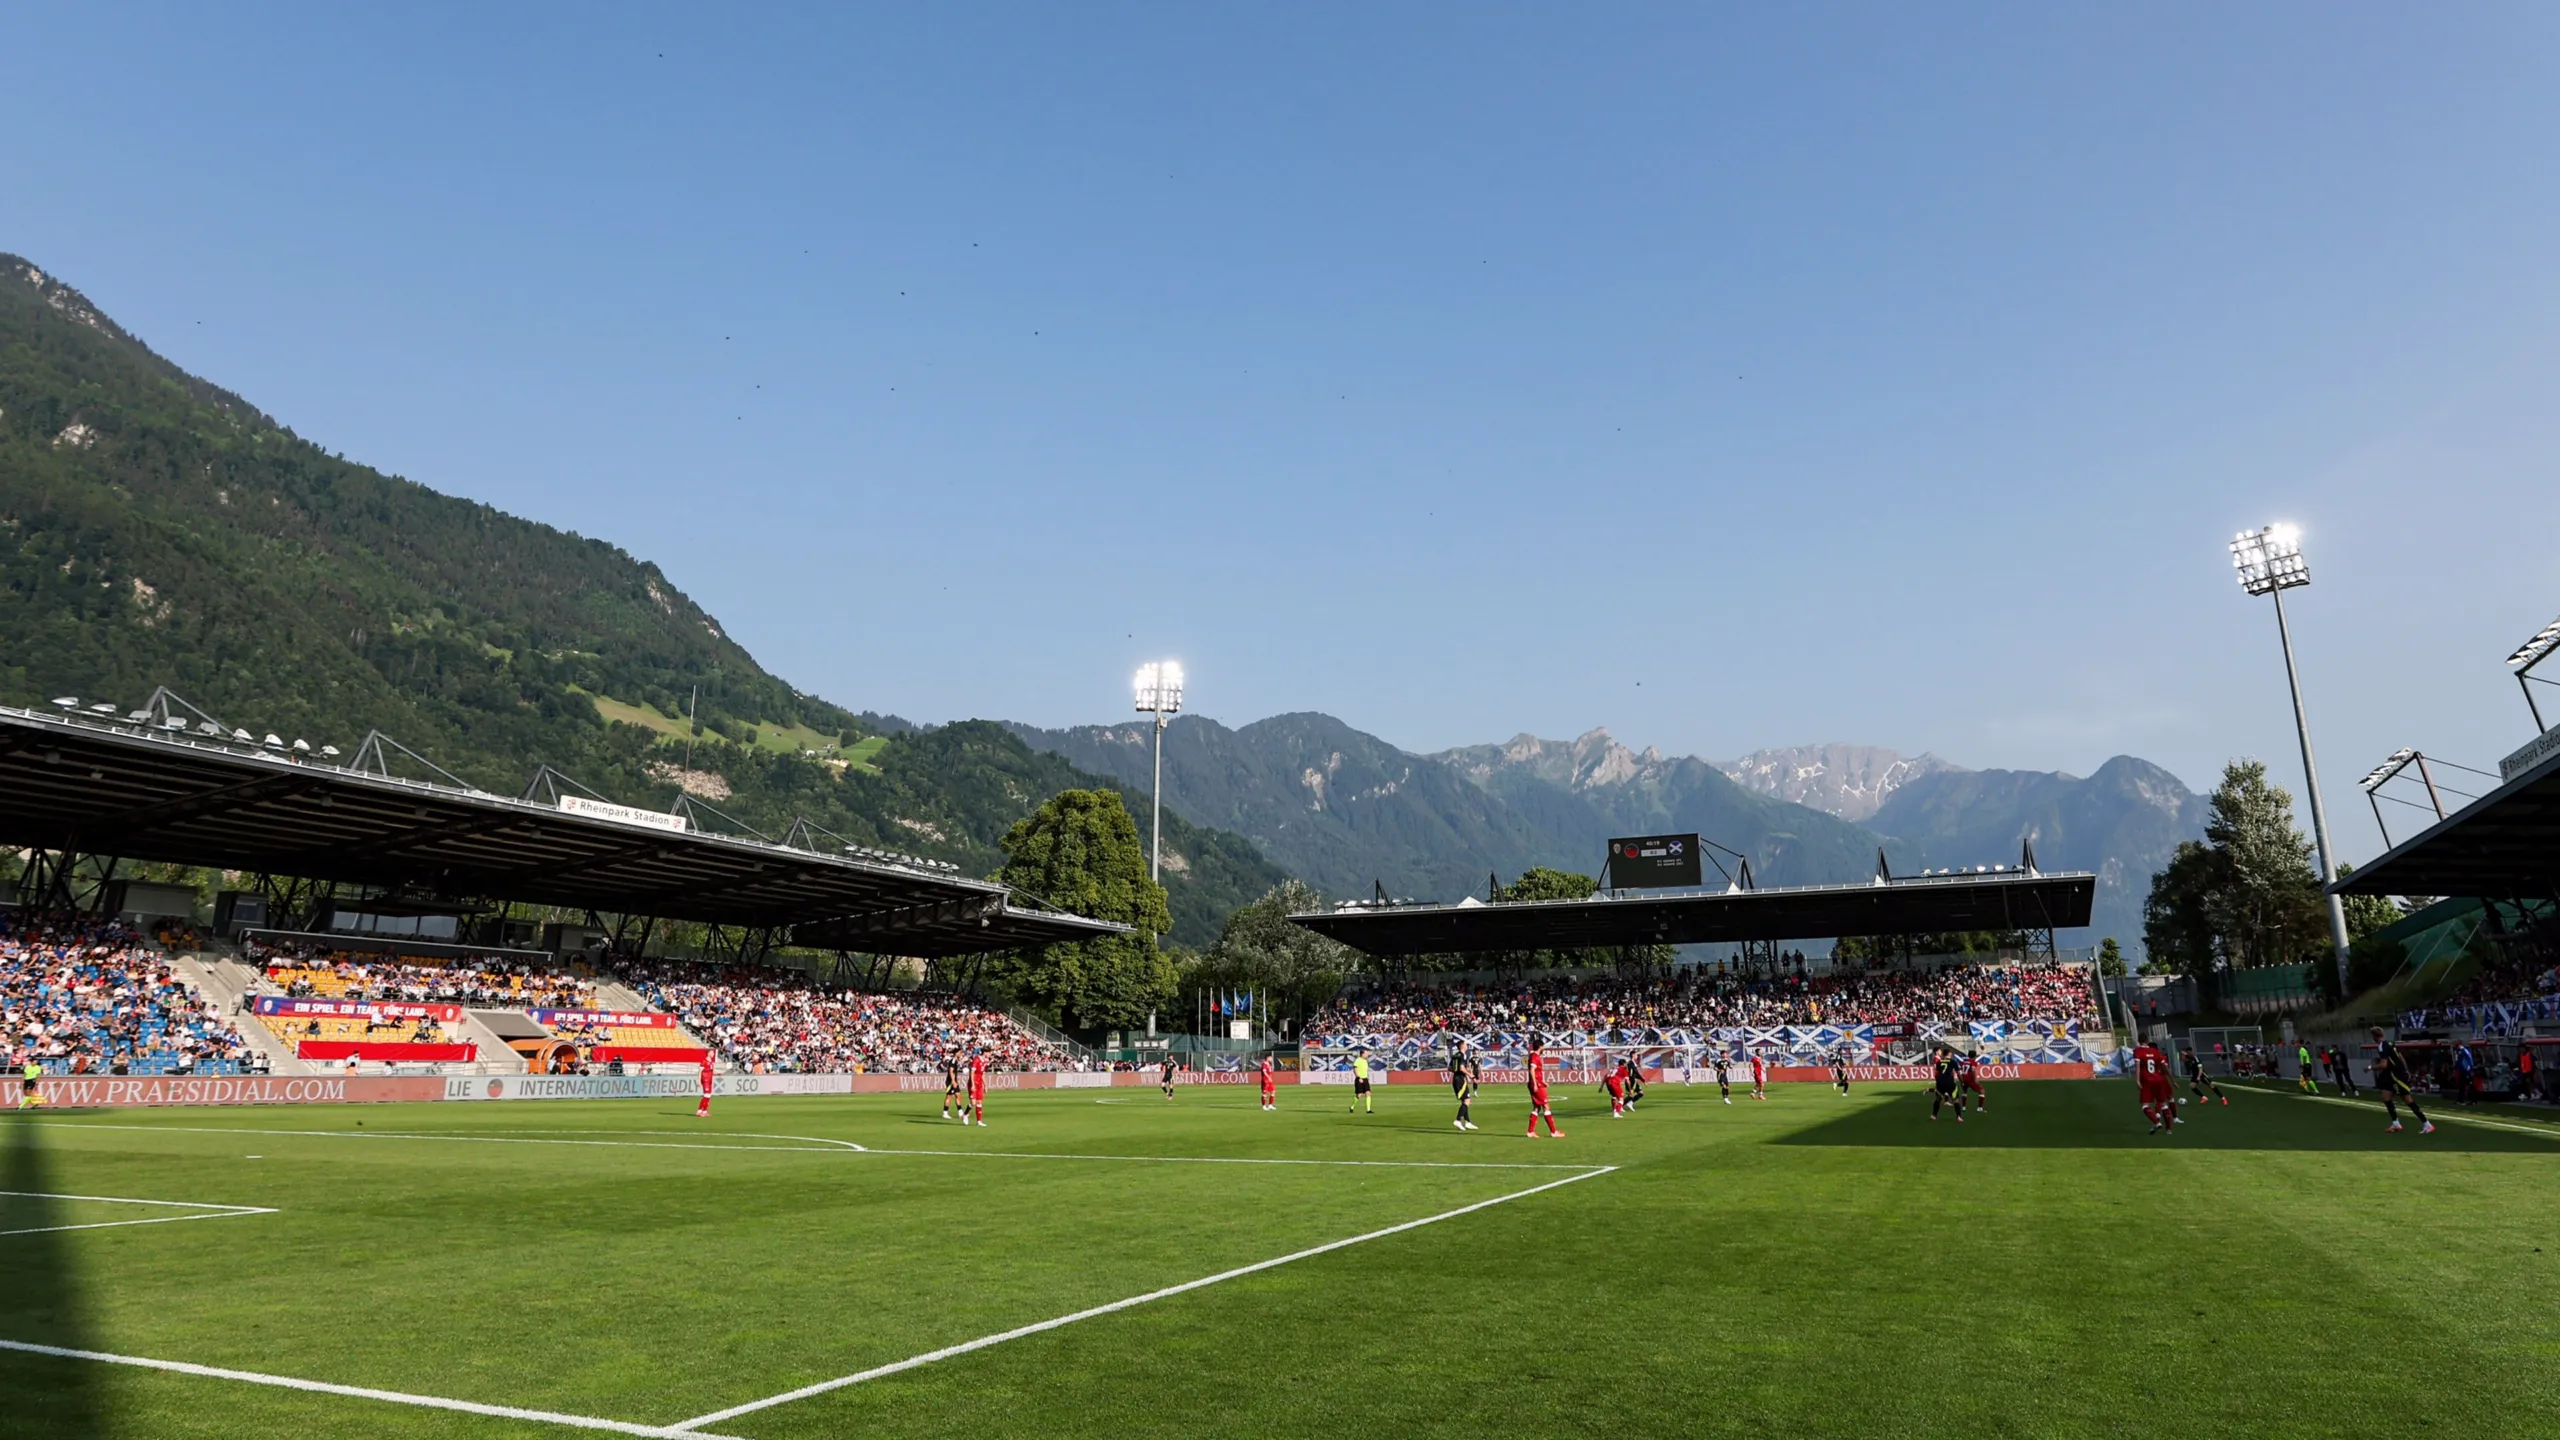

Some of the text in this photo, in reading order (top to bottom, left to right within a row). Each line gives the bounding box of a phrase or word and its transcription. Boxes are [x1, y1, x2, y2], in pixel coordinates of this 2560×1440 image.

[580, 801, 670, 826] Rheinpark Stadion
[294, 1002, 310, 1013] EIN
[311, 1003, 338, 1014] SPIEL.
[340, 1004, 355, 1015] EIN
[1940, 1063, 1948, 1074] 7
[2147, 1059, 2155, 1073] 6
[2, 1080, 345, 1104] WWW.PRAESIDIAL.COM
[449, 1080, 472, 1097] LIE
[519, 1078, 699, 1097] INTERNATIONAL FRIENDLY
[735, 1078, 759, 1094] SCO
